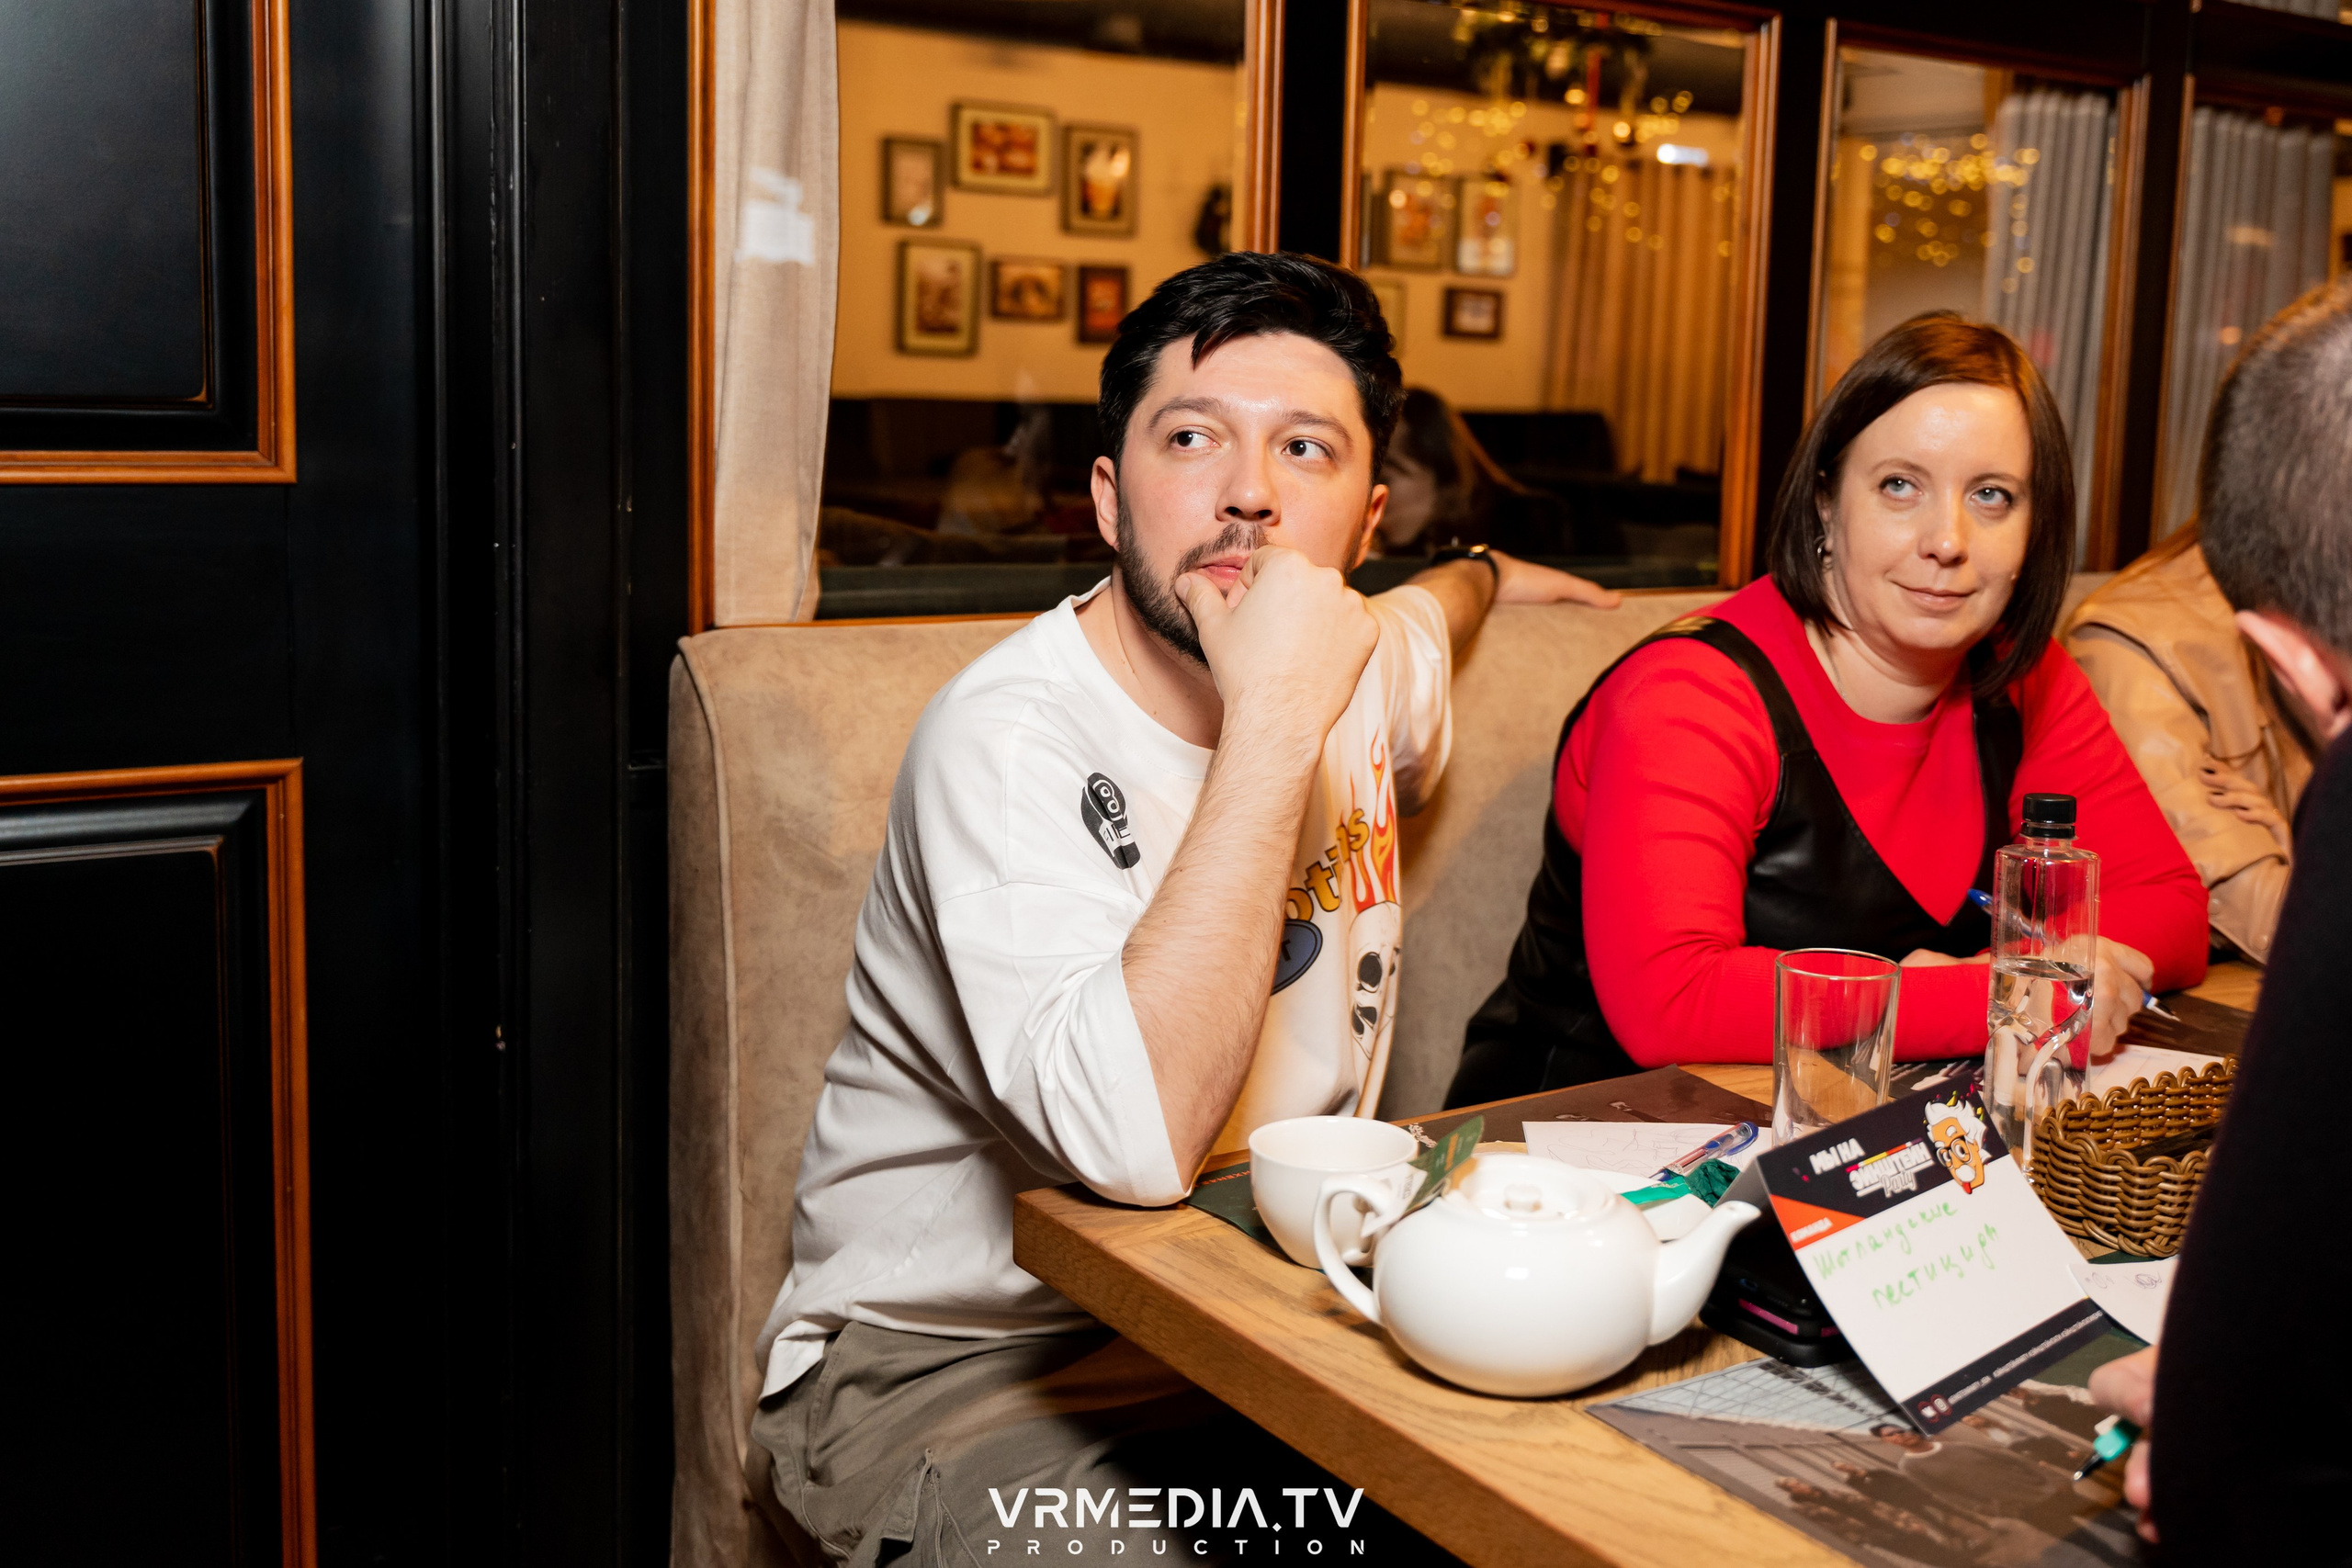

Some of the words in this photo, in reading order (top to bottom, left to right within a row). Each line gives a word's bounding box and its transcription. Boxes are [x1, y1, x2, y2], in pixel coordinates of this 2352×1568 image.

[1809, 1145, 1842, 1175] МЫ
[1837, 1137, 1866, 1164] НА
[1881, 1170, 1918, 1199] Party
